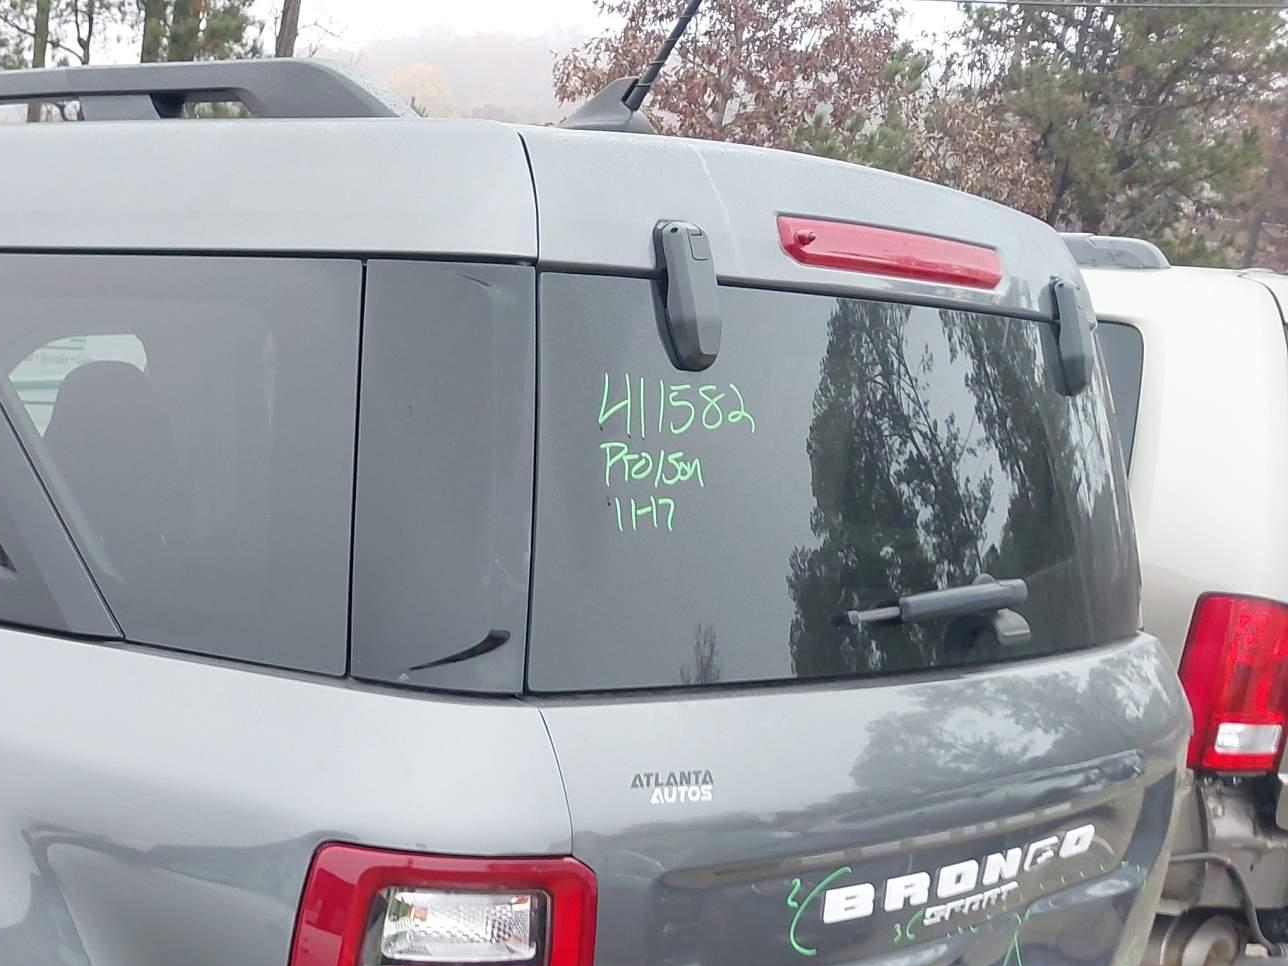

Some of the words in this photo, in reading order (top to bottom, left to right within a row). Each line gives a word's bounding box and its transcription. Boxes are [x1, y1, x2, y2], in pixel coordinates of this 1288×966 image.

[598, 372, 756, 438] 411582
[630, 769, 714, 789] ATLANTA
[649, 784, 713, 805] AUTOS
[823, 824, 1096, 924] BRONCO
